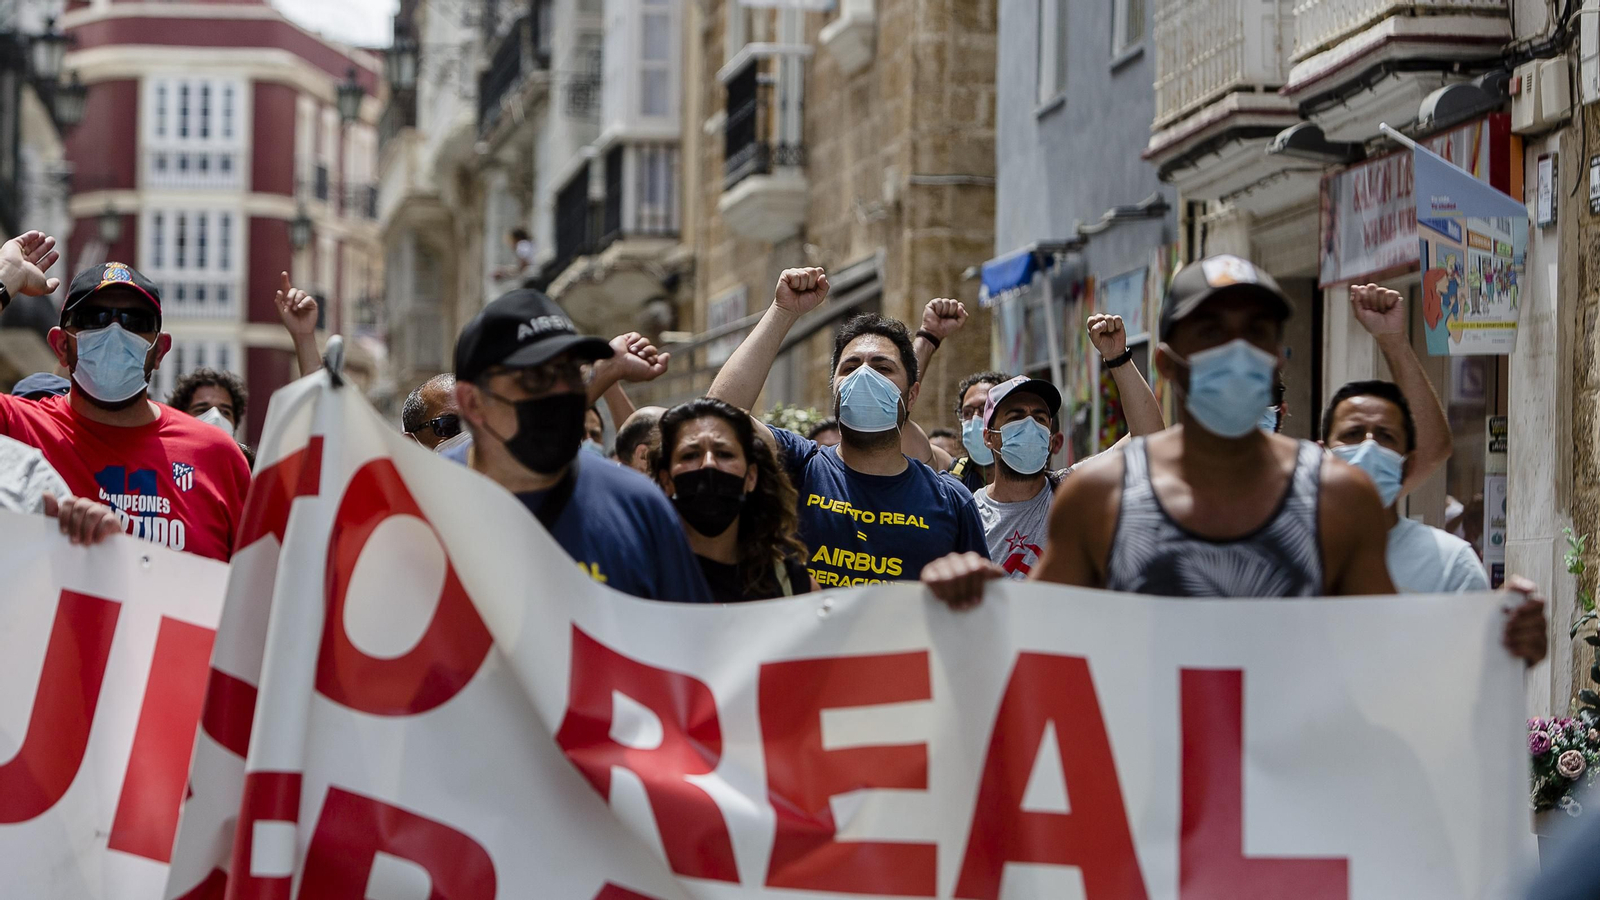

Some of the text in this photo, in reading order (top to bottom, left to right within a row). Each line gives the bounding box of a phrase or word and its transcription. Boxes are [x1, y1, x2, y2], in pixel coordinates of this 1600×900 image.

[807, 494, 930, 530] PUERTO REAL
[811, 545, 904, 576] AIRBUS
[555, 619, 1350, 900] REAL
